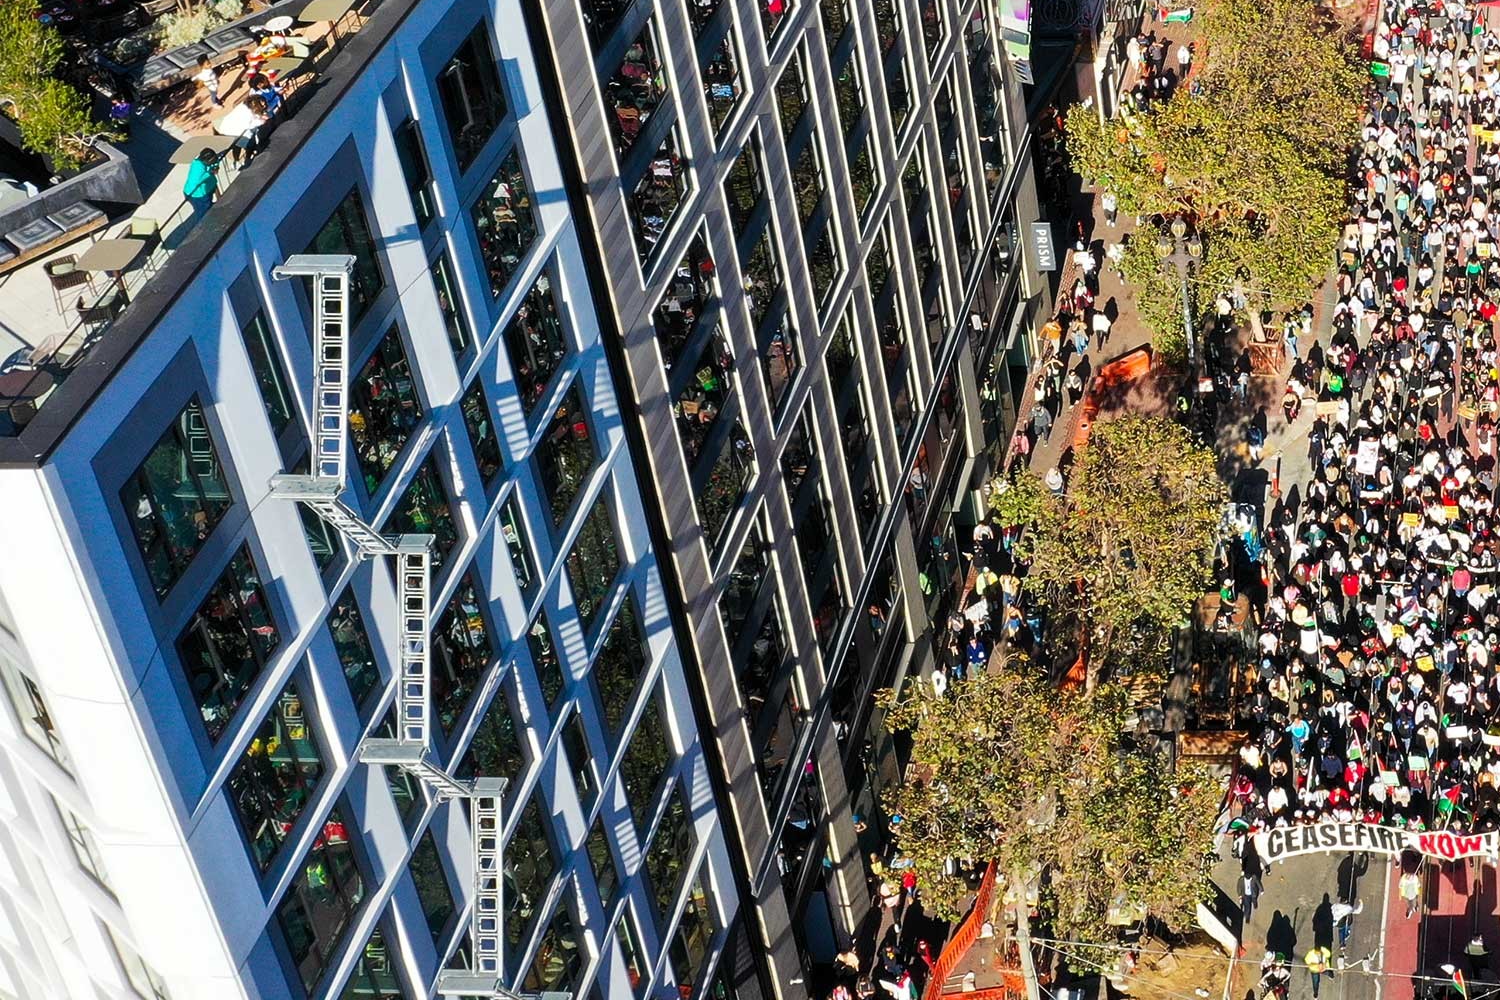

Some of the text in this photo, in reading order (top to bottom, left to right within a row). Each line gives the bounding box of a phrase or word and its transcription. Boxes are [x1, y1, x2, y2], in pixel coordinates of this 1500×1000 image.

[1035, 229, 1051, 266] PRISM
[1268, 823, 1492, 858] CEASEFIRE NOW!
